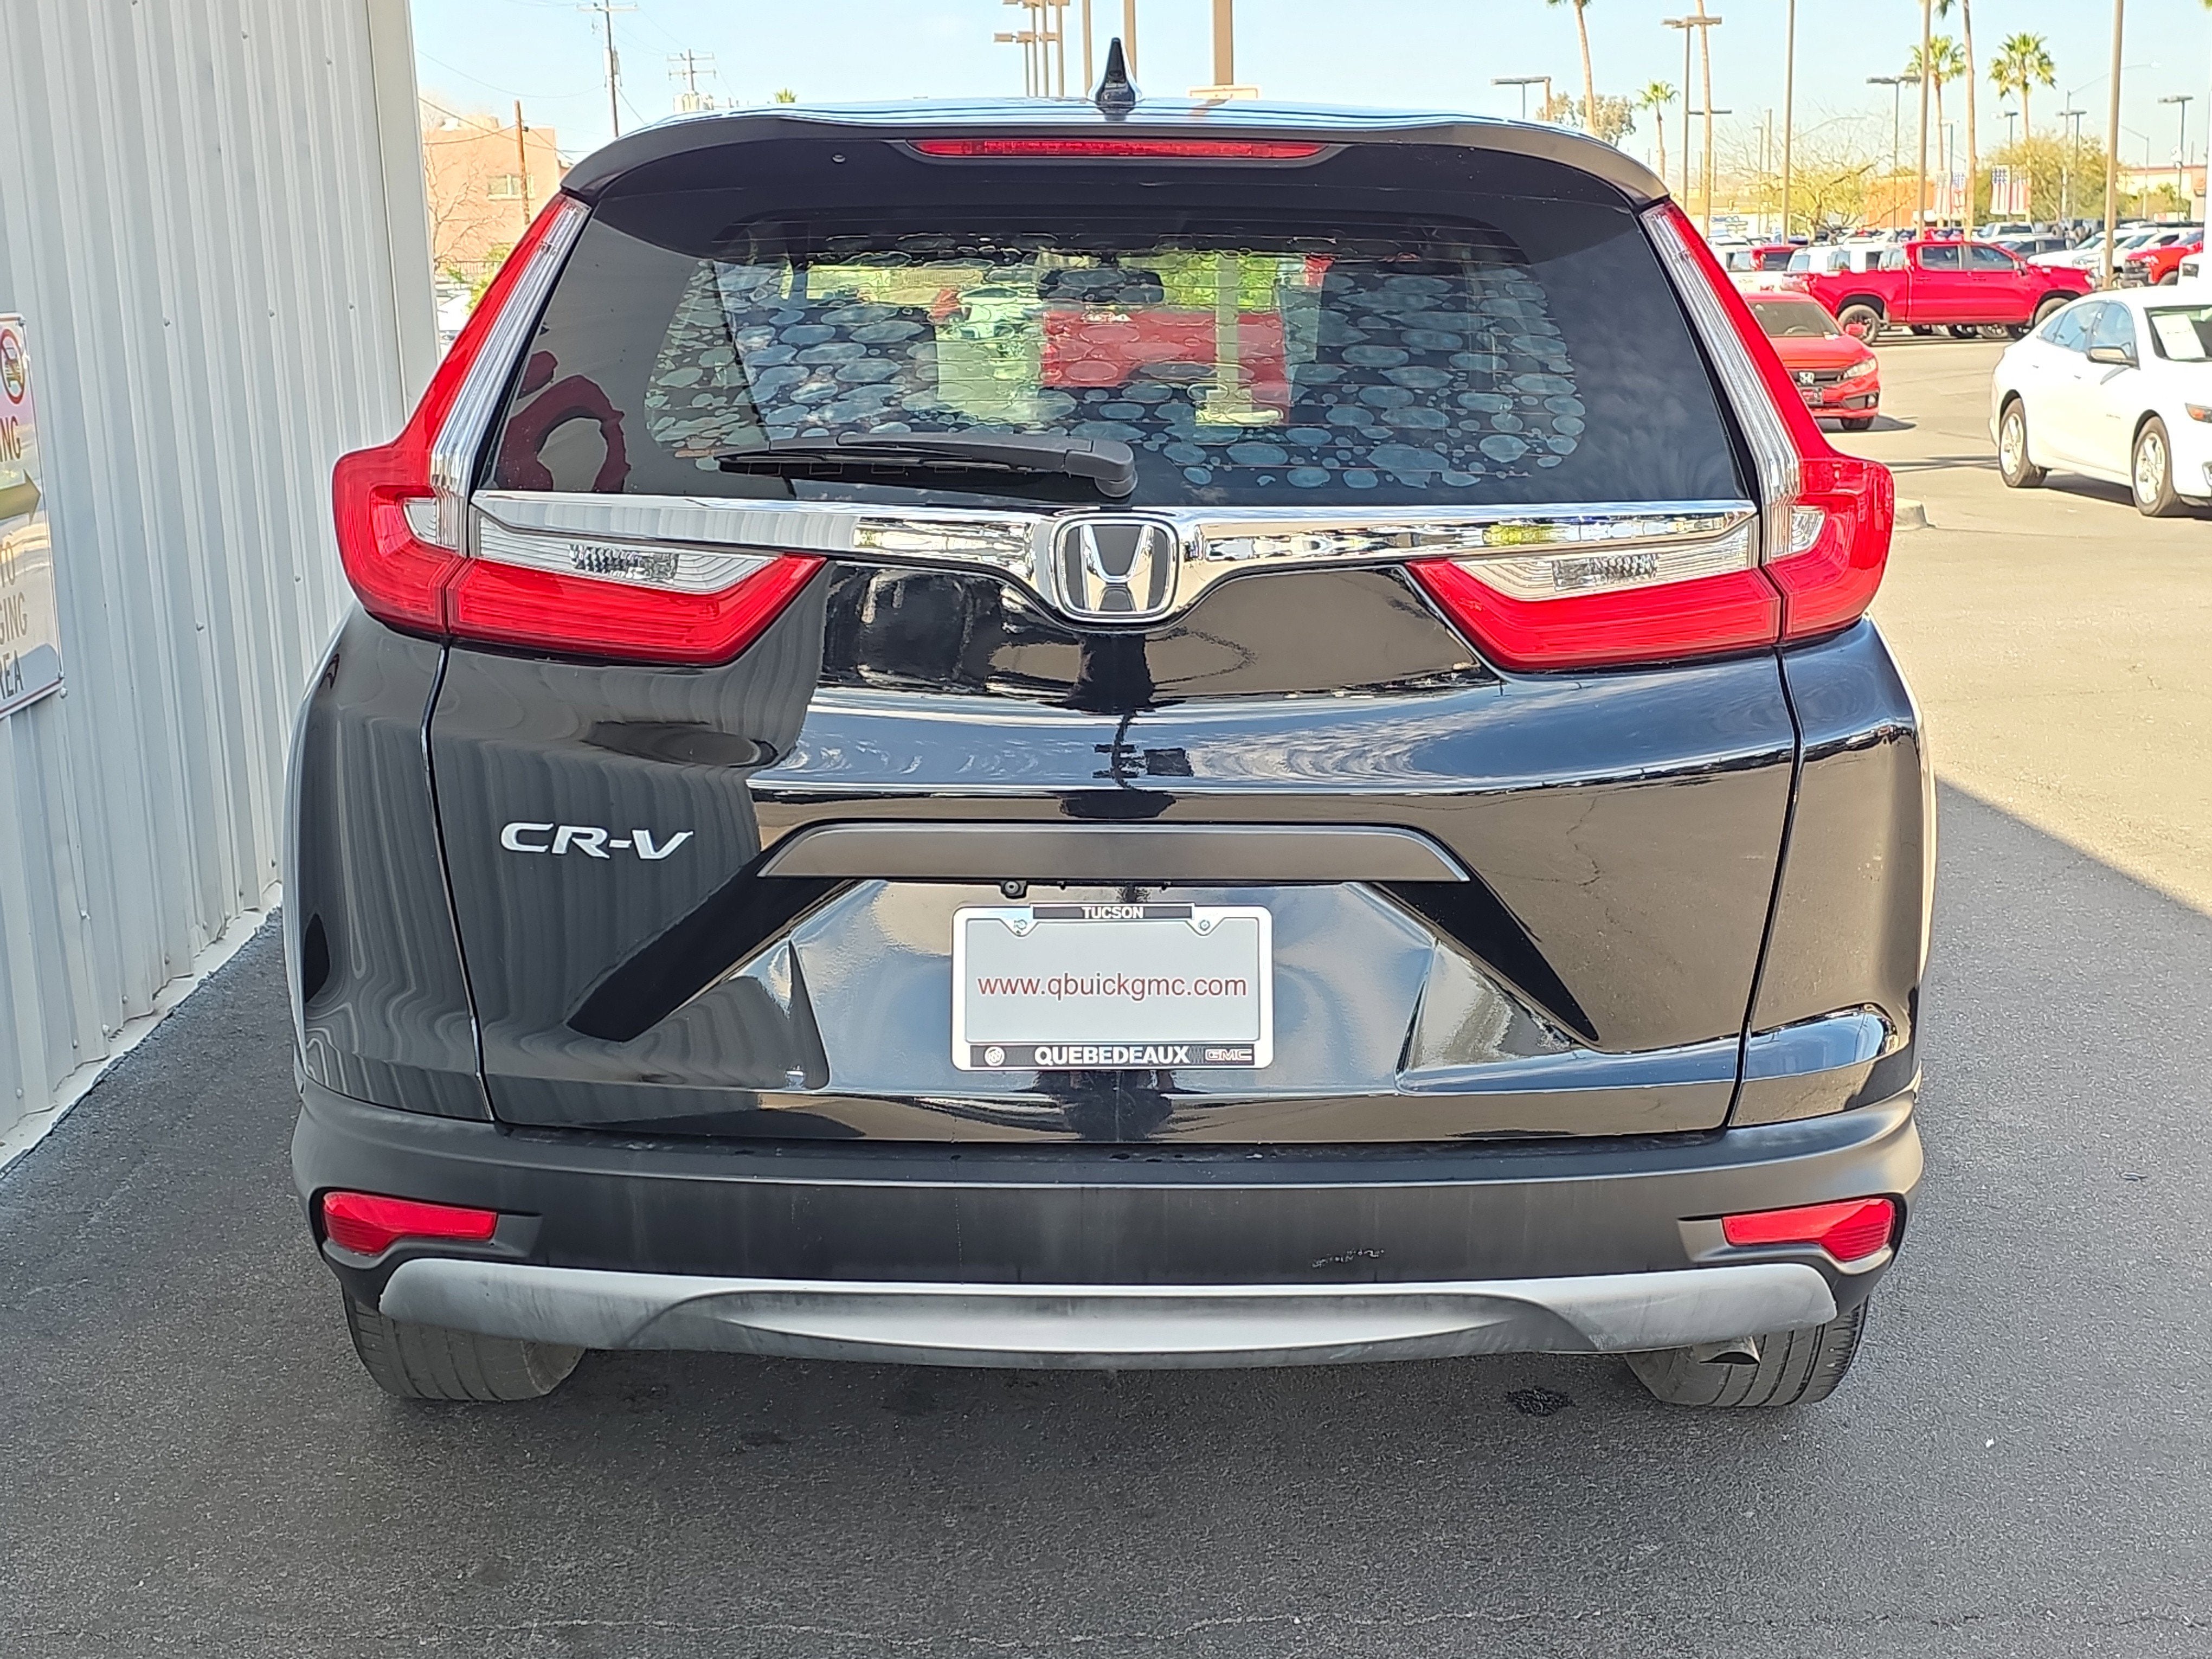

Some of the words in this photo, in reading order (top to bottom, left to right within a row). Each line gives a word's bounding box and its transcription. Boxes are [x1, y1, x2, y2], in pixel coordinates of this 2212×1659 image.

[500, 822, 694, 860] CR-V
[1081, 906, 1144, 919] TUCSON
[977, 973, 1247, 1001] www.qbuickgmc.com
[1034, 1046, 1191, 1066] QUEBEDEAUX
[1205, 1049, 1252, 1061] GMC
